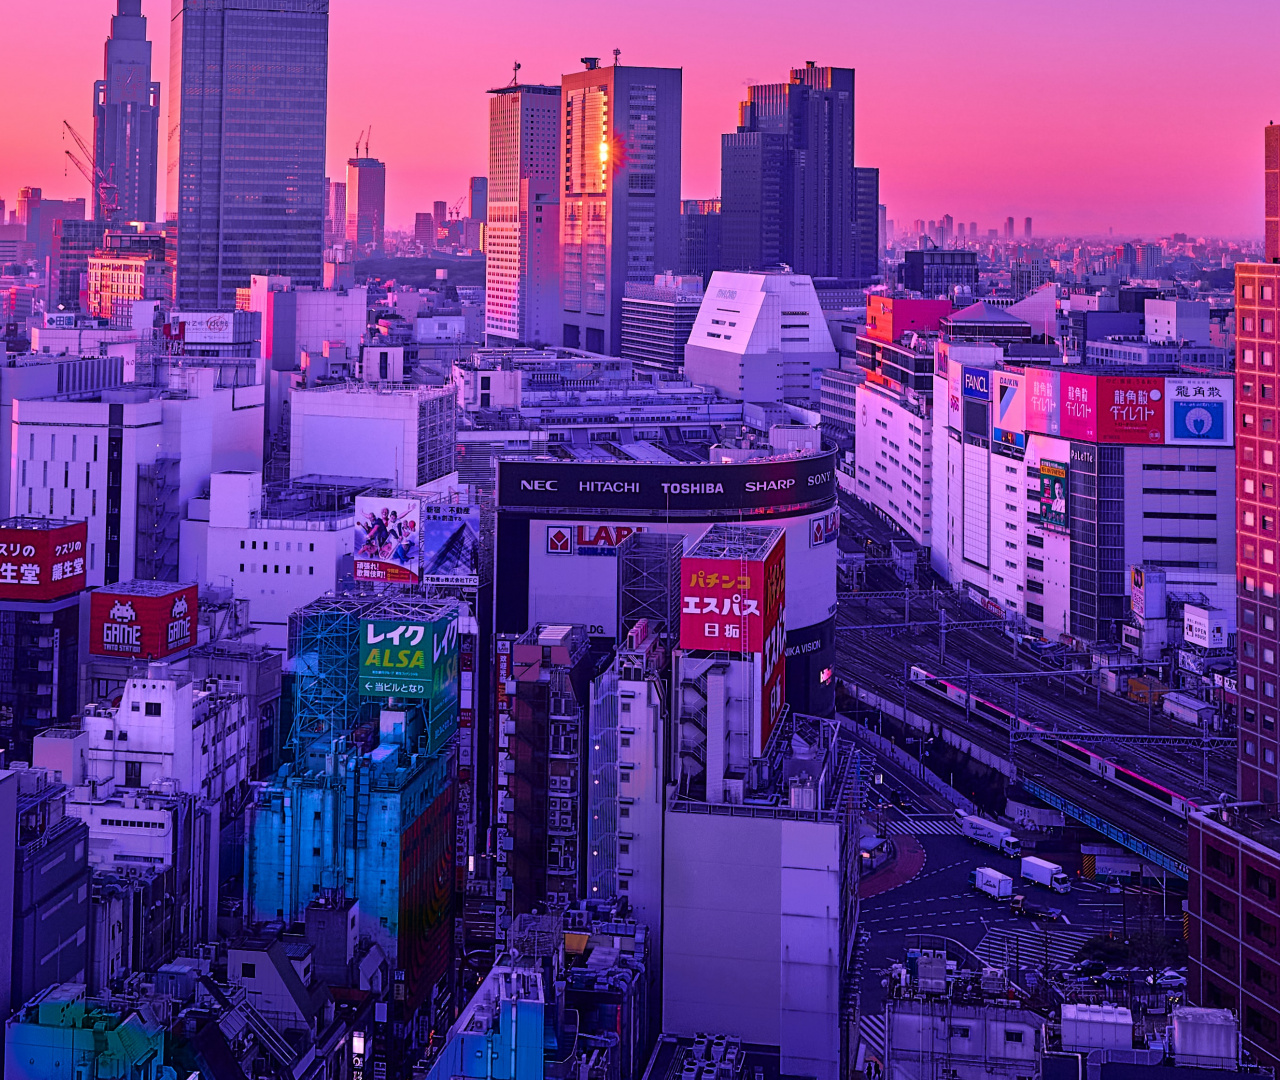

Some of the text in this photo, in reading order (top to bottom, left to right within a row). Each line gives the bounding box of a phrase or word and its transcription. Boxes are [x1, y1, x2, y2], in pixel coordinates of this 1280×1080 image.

[965, 374, 988, 393] FANCL
[999, 377, 1019, 387] DAIKIN
[1114, 389, 1149, 406] 龍角散
[1175, 385, 1222, 398] 龍角散
[521, 480, 558, 491] NEC
[579, 481, 640, 493] HITACHI
[745, 479, 796, 492] SHARP
[808, 471, 831, 487] SONY
[661, 482, 724, 494] TOSHIBA
[55, 541, 82, 557] クスリの
[51, 558, 84, 582] 龍生堂
[690, 570, 751, 590] パチンコ
[683, 594, 760, 617] エスパス
[103, 622, 141, 645] GAME
[168, 616, 191, 643] GAME
[367, 624, 425, 646] レイク
[801, 639, 821, 654] VISION
[365, 648, 425, 669] ALSA
[375, 682, 424, 693] 当ビルとなり
